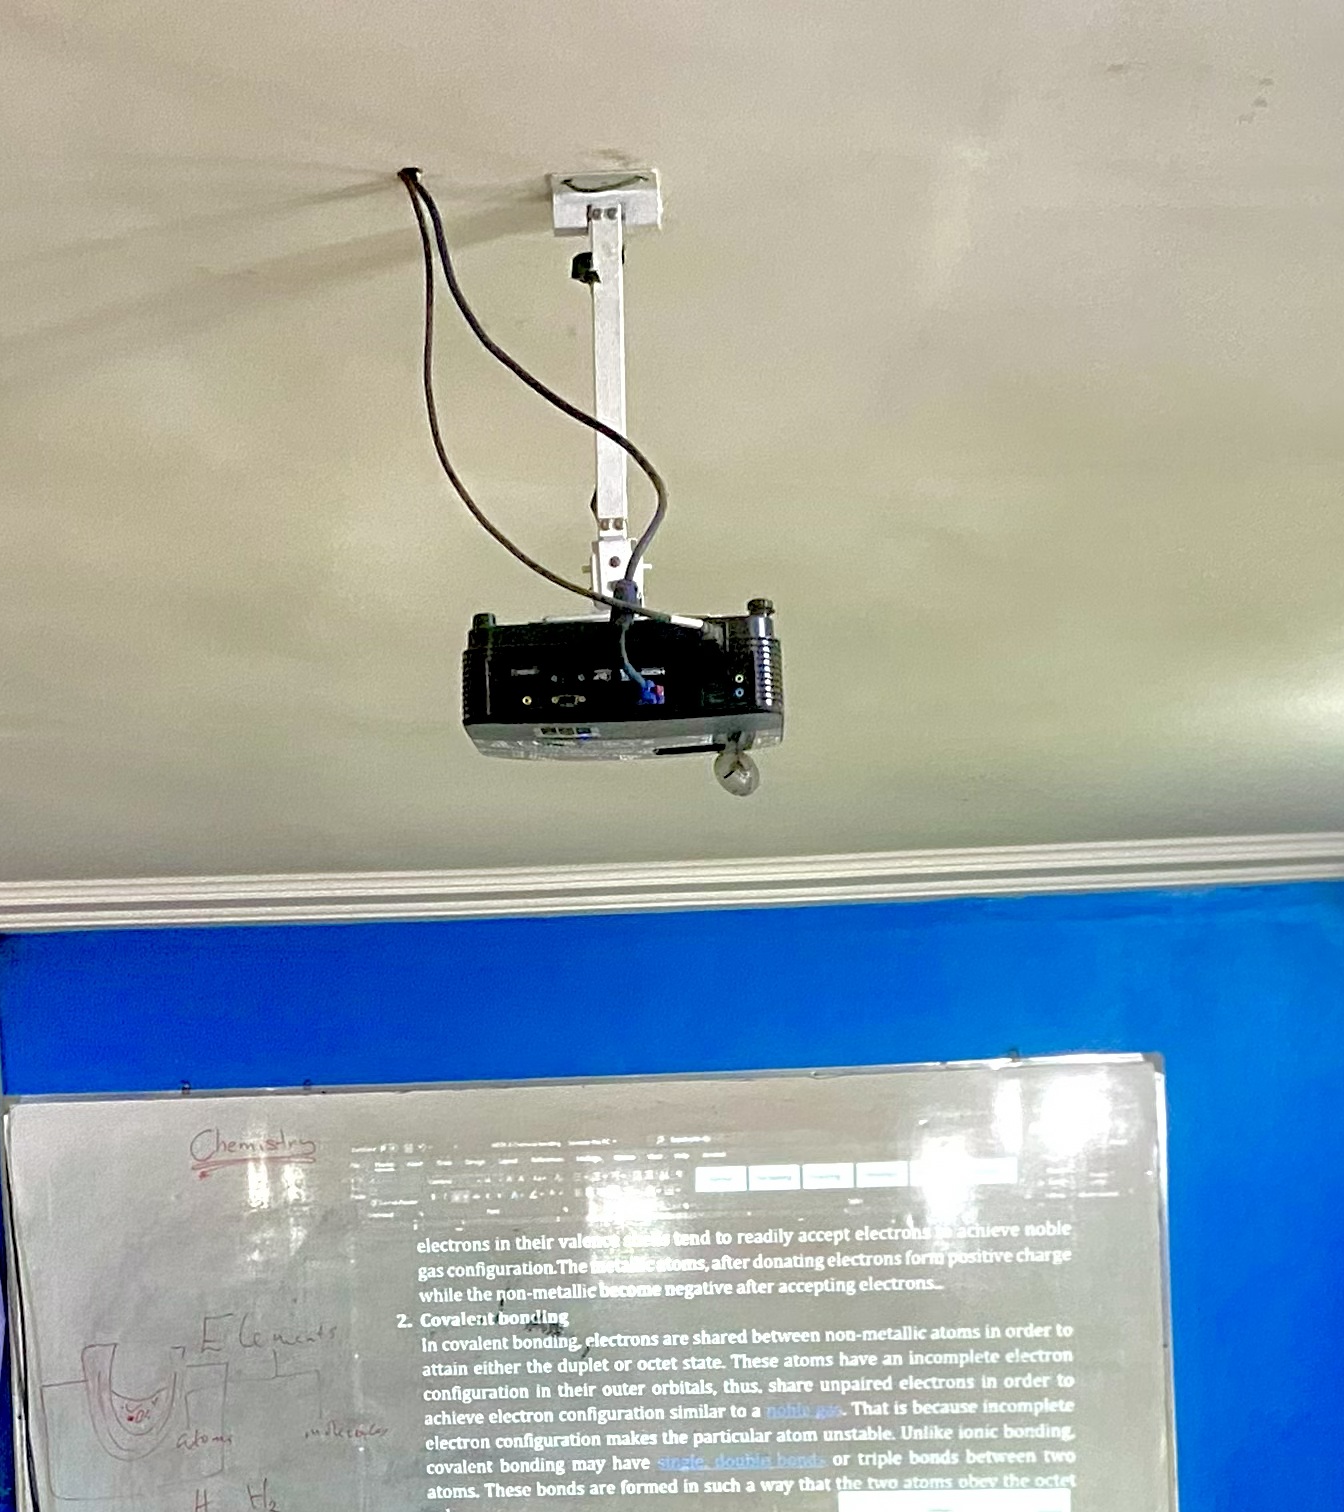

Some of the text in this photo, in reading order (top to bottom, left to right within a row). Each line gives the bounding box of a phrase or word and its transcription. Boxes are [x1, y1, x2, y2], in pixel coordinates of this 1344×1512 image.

[189, 1128, 317, 1158] Chemistry
[416, 1237, 490, 1253] electrons
[494, 1237, 510, 1251] in
[515, 1236, 552, 1250] their
[672, 1231, 711, 1246] tend
[715, 1231, 732, 1245] to
[736, 1229, 794, 1248] readily
[797, 1227, 850, 1246] accept
[854, 1225, 931, 1241] electrons
[955, 1223, 1019, 1238] achieve
[1023, 1221, 1072, 1236] noble
[417, 1266, 443, 1281] gas
[657, 1256, 709, 1273] atoms,
[711, 1254, 750, 1270] after
[752, 1253, 825, 1272] donating
[827, 1251, 902, 1266] electrons
[904, 1250, 944, 1264] form
[947, 1248, 1013, 1267] positive
[1016, 1246, 1072, 1266] charge
[419, 1286, 463, 1301] while
[466, 1285, 492, 1300] the
[496, 1283, 595, 1299] non-metallic
[597, 1281, 661, 1297] become
[665, 1279, 733, 1299] negative
[735, 1278, 774, 1294] after
[777, 1277, 855, 1296] accepting
[201, 1312, 337, 1353] Elements
[397, 1309, 570, 1329] 2. Covalent bonding
[421, 1336, 437, 1351] In
[441, 1335, 509, 1351] covalent
[585, 1332, 659, 1347] electrons
[662, 1334, 689, 1346] are
[692, 1329, 747, 1345] shared
[751, 1328, 820, 1344] between
[825, 1326, 926, 1342] non-metallic
[930, 1324, 980, 1340] atoms
[984, 1324, 1001, 1338] in
[1005, 1322, 1051, 1338] order
[1055, 1322, 1073, 1337] to
[421, 1346, 1073, 1376] attain either the duplet or octet state. These atoms have an incomplete electron
[423, 1383, 528, 1403] configuration
[535, 1382, 550, 1397] in
[557, 1382, 593, 1397] their
[601, 1381, 645, 1396] outer
[651, 1379, 717, 1397] orbitals,
[767, 1377, 814, 1393] share
[819, 1376, 892, 1396] unpaired
[898, 1374, 975, 1390] electrons
[980, 1374, 997, 1389] in
[1003, 1373, 1050, 1388] order
[1056, 1372, 1075, 1387] to
[423, 1409, 484, 1424] achieve
[488, 1407, 553, 1423] electron
[558, 1405, 664, 1425] configuration
[669, 1404, 726, 1419] similar
[729, 1403, 747, 1418] to
[750, 1406, 760, 1418] a
[850, 1400, 888, 1415] That
[893, 1400, 907, 1415] is
[912, 1398, 978, 1414] because
[981, 1397, 1075, 1416] incomplete
[425, 1434, 490, 1449] electron
[494, 1432, 601, 1451] configuration
[606, 1430, 657, 1445] makes
[661, 1430, 688, 1444] the
[692, 1428, 772, 1448] particular
[776, 1428, 818, 1442] atom
[823, 1426, 896, 1441] unstable.
[900, 1425, 952, 1440] Unlike
[957, 1424, 998, 1439] ionic
[426, 1458, 493, 1473] covalent
[499, 1457, 565, 1476] bonding
[571, 1459, 606, 1474] may
[611, 1455, 650, 1470] have
[832, 1455, 850, 1466] or
[857, 1451, 902, 1469] triple
[908, 1450, 959, 1464] bonds
[965, 1448, 1037, 1463] between
[1042, 1447, 1076, 1462] two
[427, 1483, 479, 1498] atoms.
[483, 1482, 531, 1497] These
[535, 1481, 584, 1496] bonds
[588, 1484, 615, 1495] are
[620, 1479, 678, 1494] formed
[683, 1479, 698, 1493] in
[703, 1478, 740, 1493] such
[745, 1481, 755, 1492] a
[759, 1480, 794, 1495] way
[798, 1476, 830, 1491] that
[835, 1475, 862, 1490] the
[866, 1475, 898, 1489] two
[902, 1474, 953, 1489] atoms
[1002, 1472, 1029, 1487] the
[1034, 1471, 1076, 1486] octet
